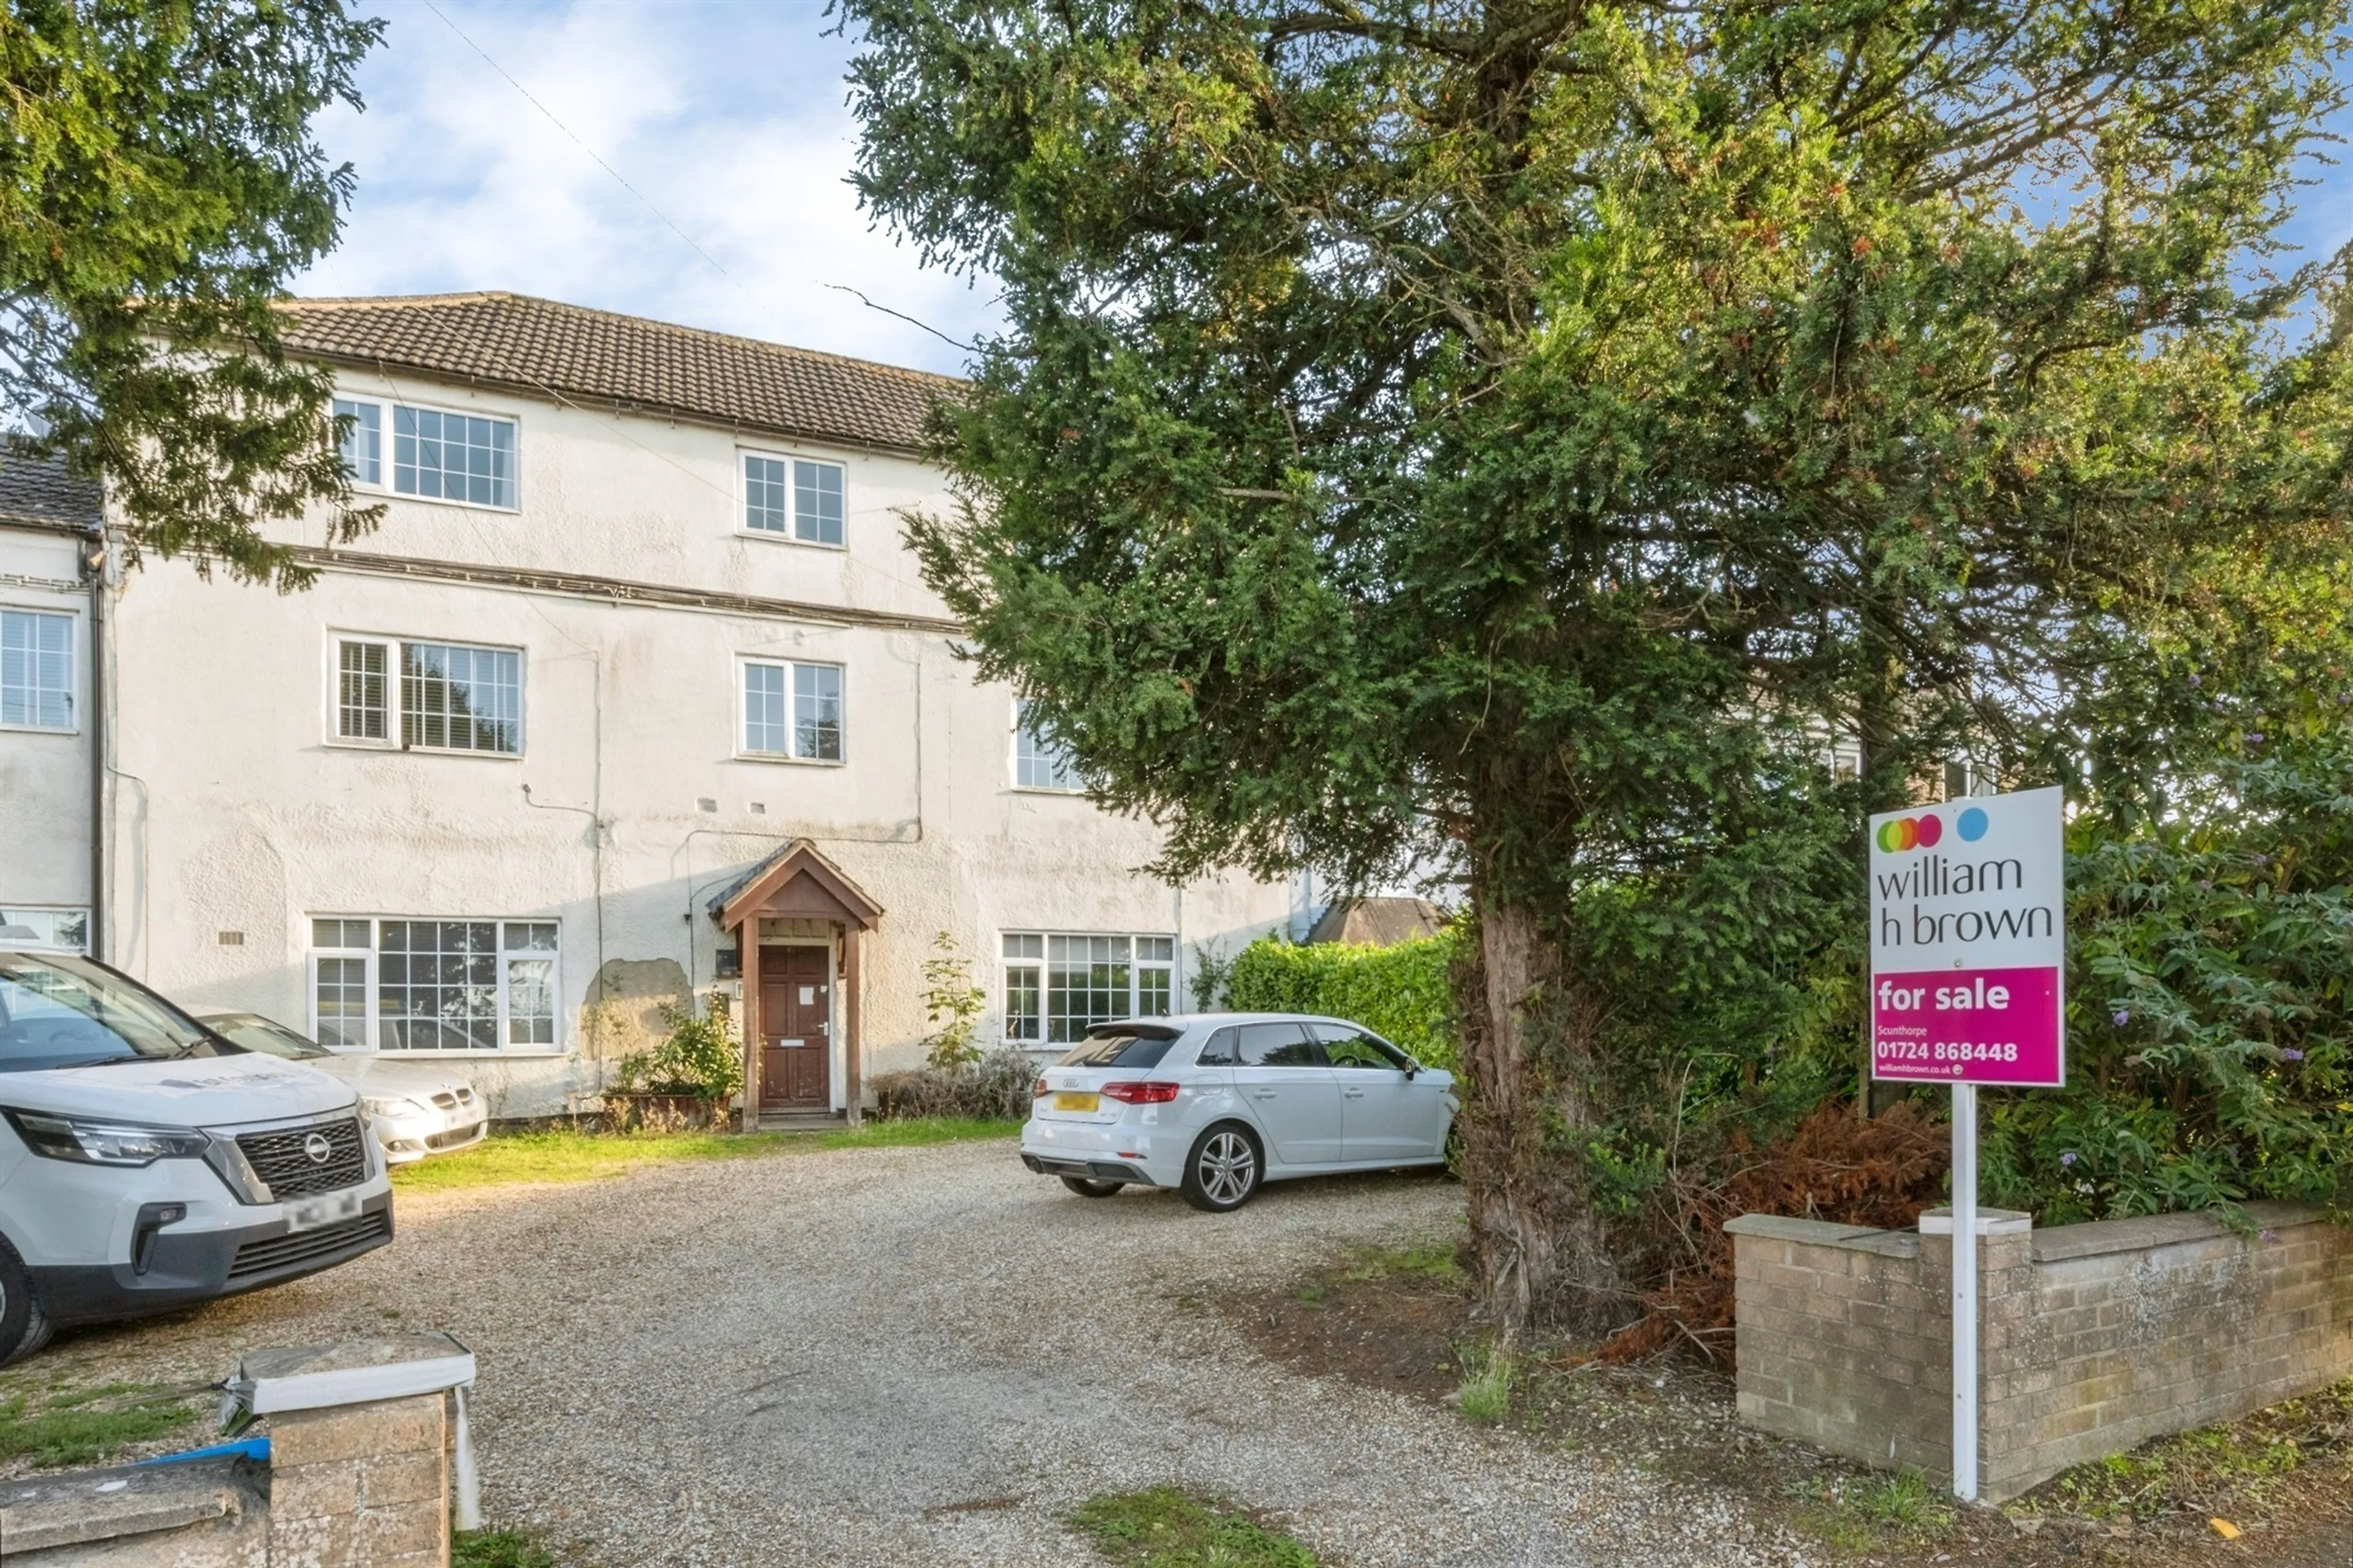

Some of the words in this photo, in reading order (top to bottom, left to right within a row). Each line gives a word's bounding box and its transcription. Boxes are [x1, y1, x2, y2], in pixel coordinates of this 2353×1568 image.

[1877, 854, 2022, 901] william
[1882, 907, 1901, 946] h
[1914, 904, 2052, 945] brown
[1878, 980, 1926, 1011] for
[1935, 977, 2010, 1010] sale
[1877, 1025, 1928, 1037] Scunthorpe
[1877, 1041, 1929, 1059] 01724
[1934, 1042, 2018, 1061] 868448
[1879, 1064, 1951, 1074] williamhbrown.co.uk
